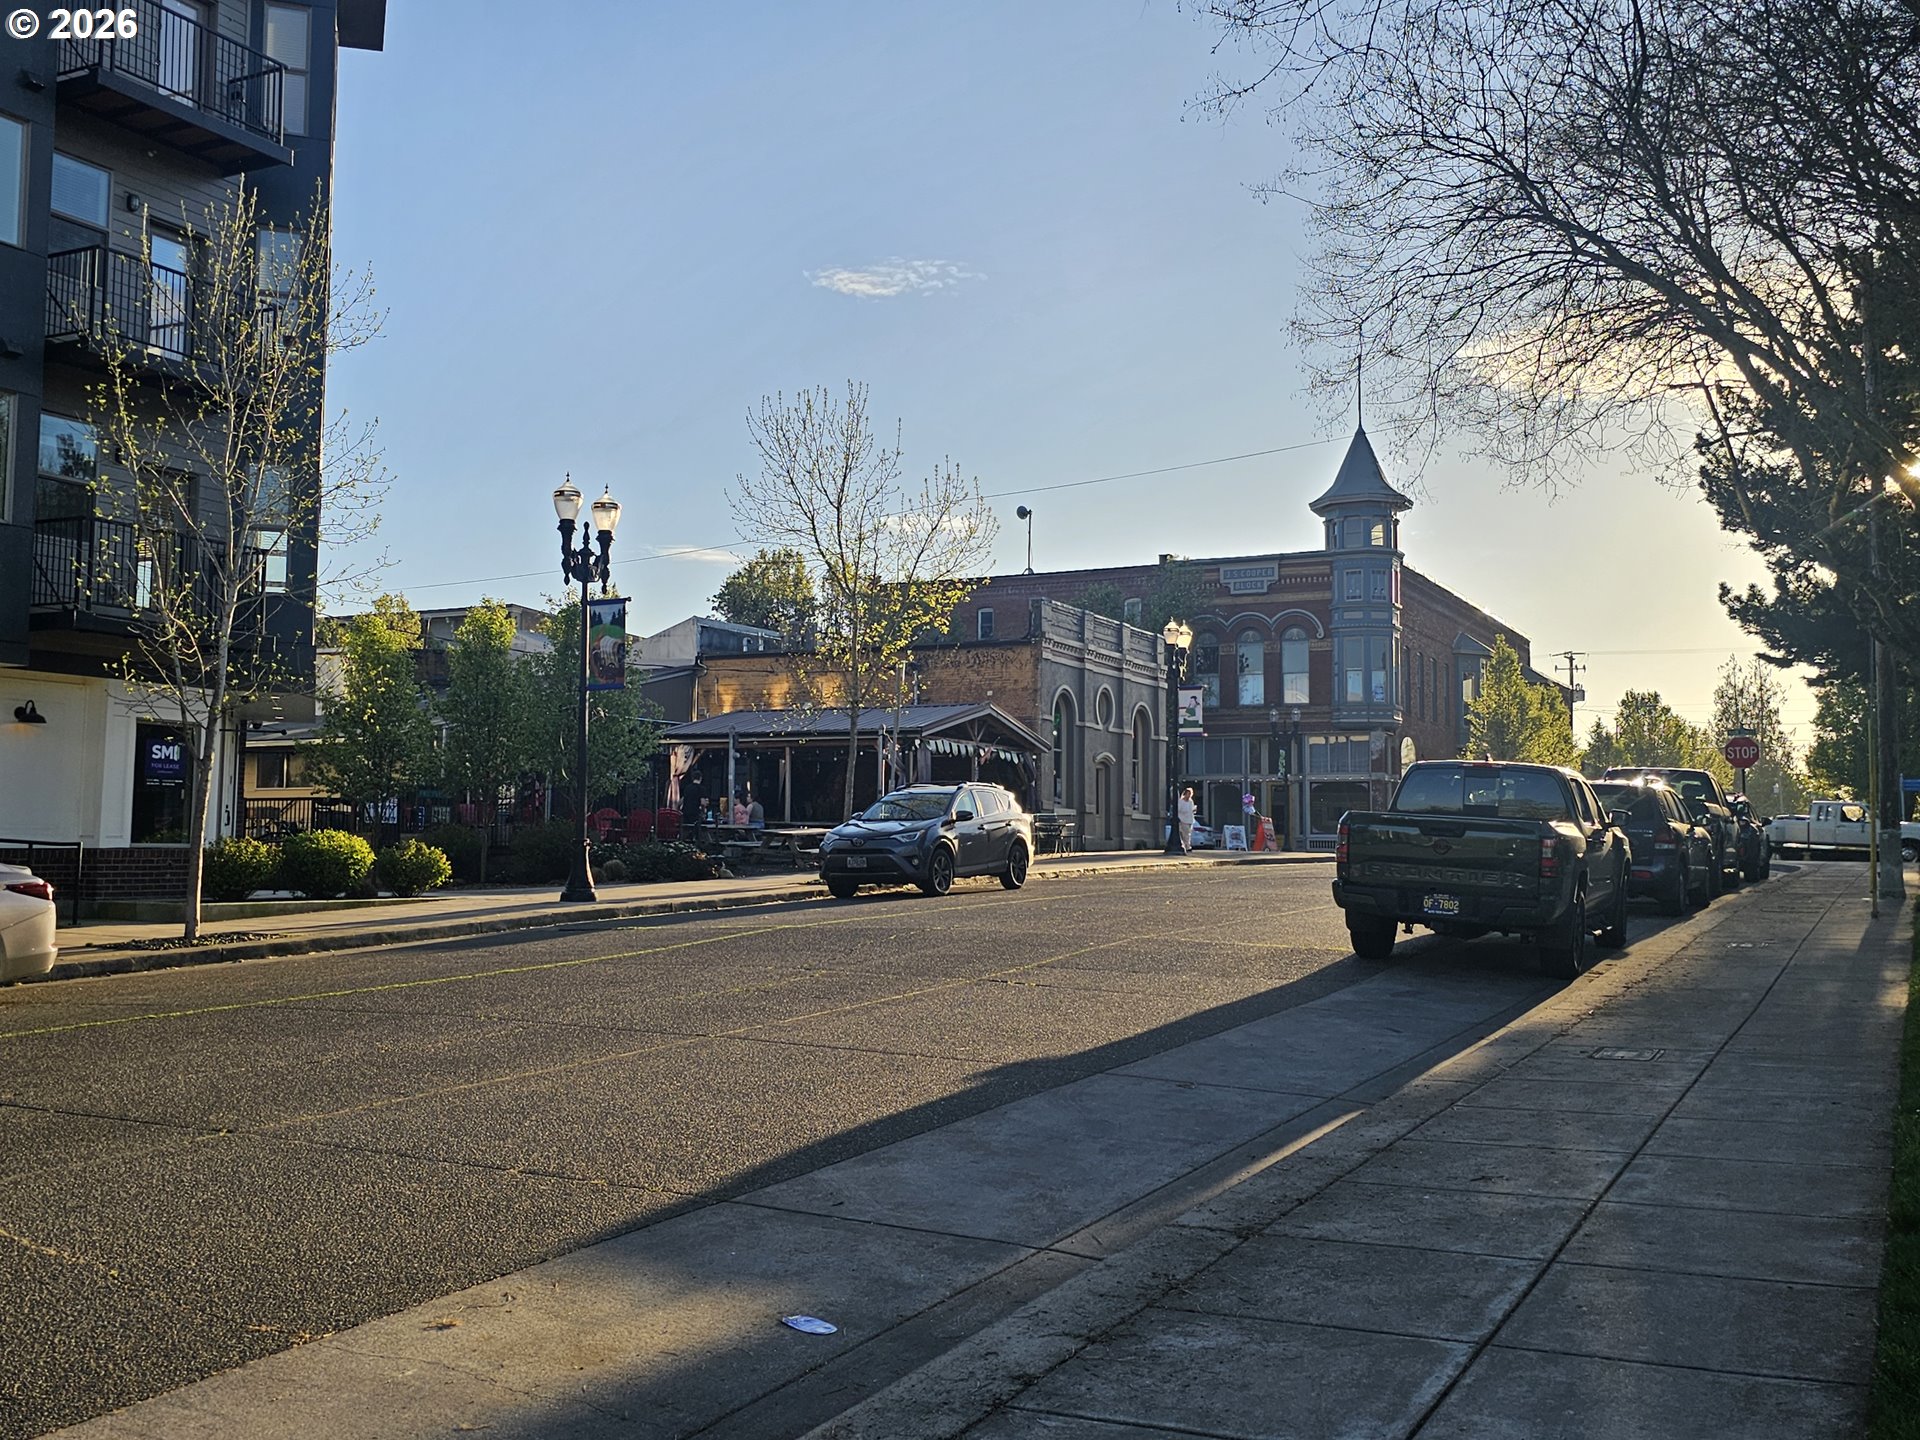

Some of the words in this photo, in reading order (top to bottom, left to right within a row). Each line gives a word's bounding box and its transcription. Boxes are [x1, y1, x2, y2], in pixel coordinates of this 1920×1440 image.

[1240, 568, 1273, 577] COOPER
[1235, 581, 1262, 590] BLOCK
[1727, 746, 1758, 759] STOP
[1362, 862, 1527, 889] FRONTIER
